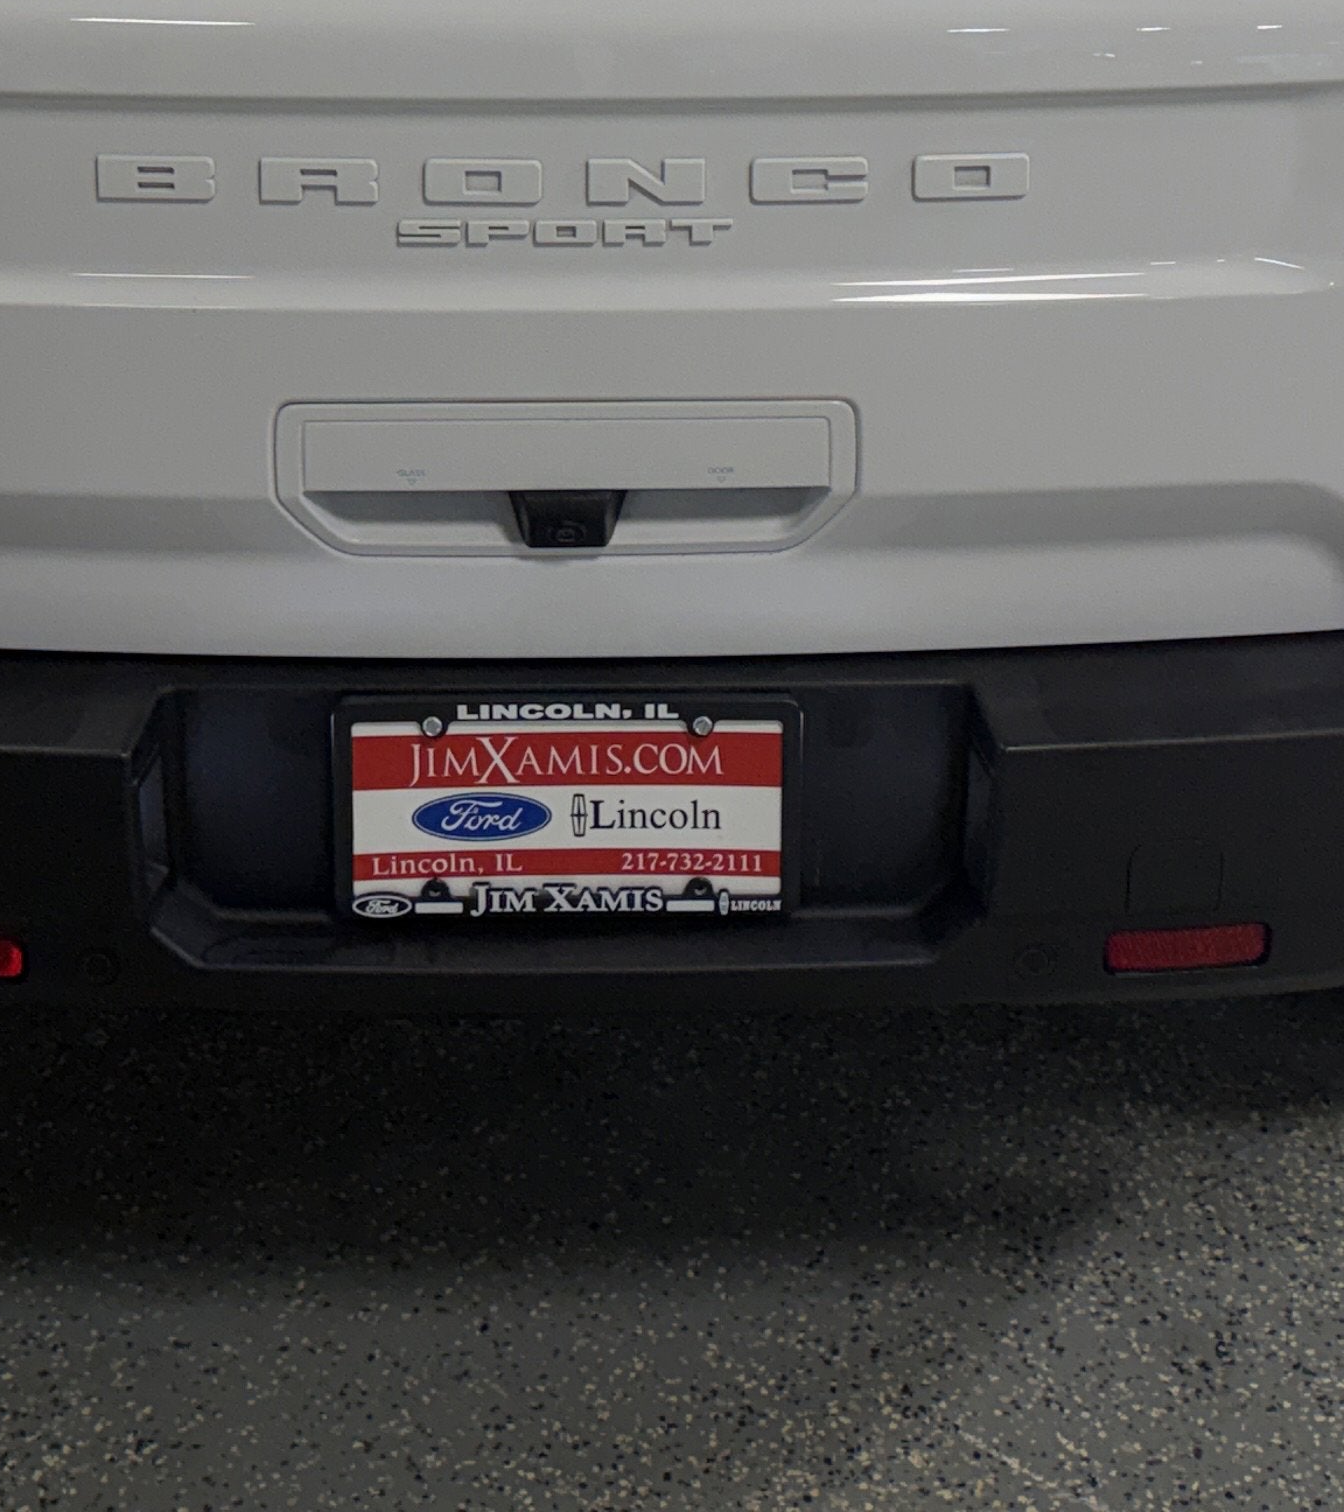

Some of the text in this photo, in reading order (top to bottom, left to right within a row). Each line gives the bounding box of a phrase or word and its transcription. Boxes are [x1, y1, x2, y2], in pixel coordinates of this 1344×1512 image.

[96, 152, 1030, 206] BRONCO
[396, 217, 733, 247] SPORT
[456, 703, 679, 720] LINCOLN, IL
[440, 800, 521, 831] Ford
[589, 800, 722, 830] Lincoln
[372, 853, 523, 875] Lincoln, IL
[621, 854, 763, 872] 217-732-2111
[471, 885, 664, 916] JIM XAMIS
[731, 900, 782, 911] LINCOLN
